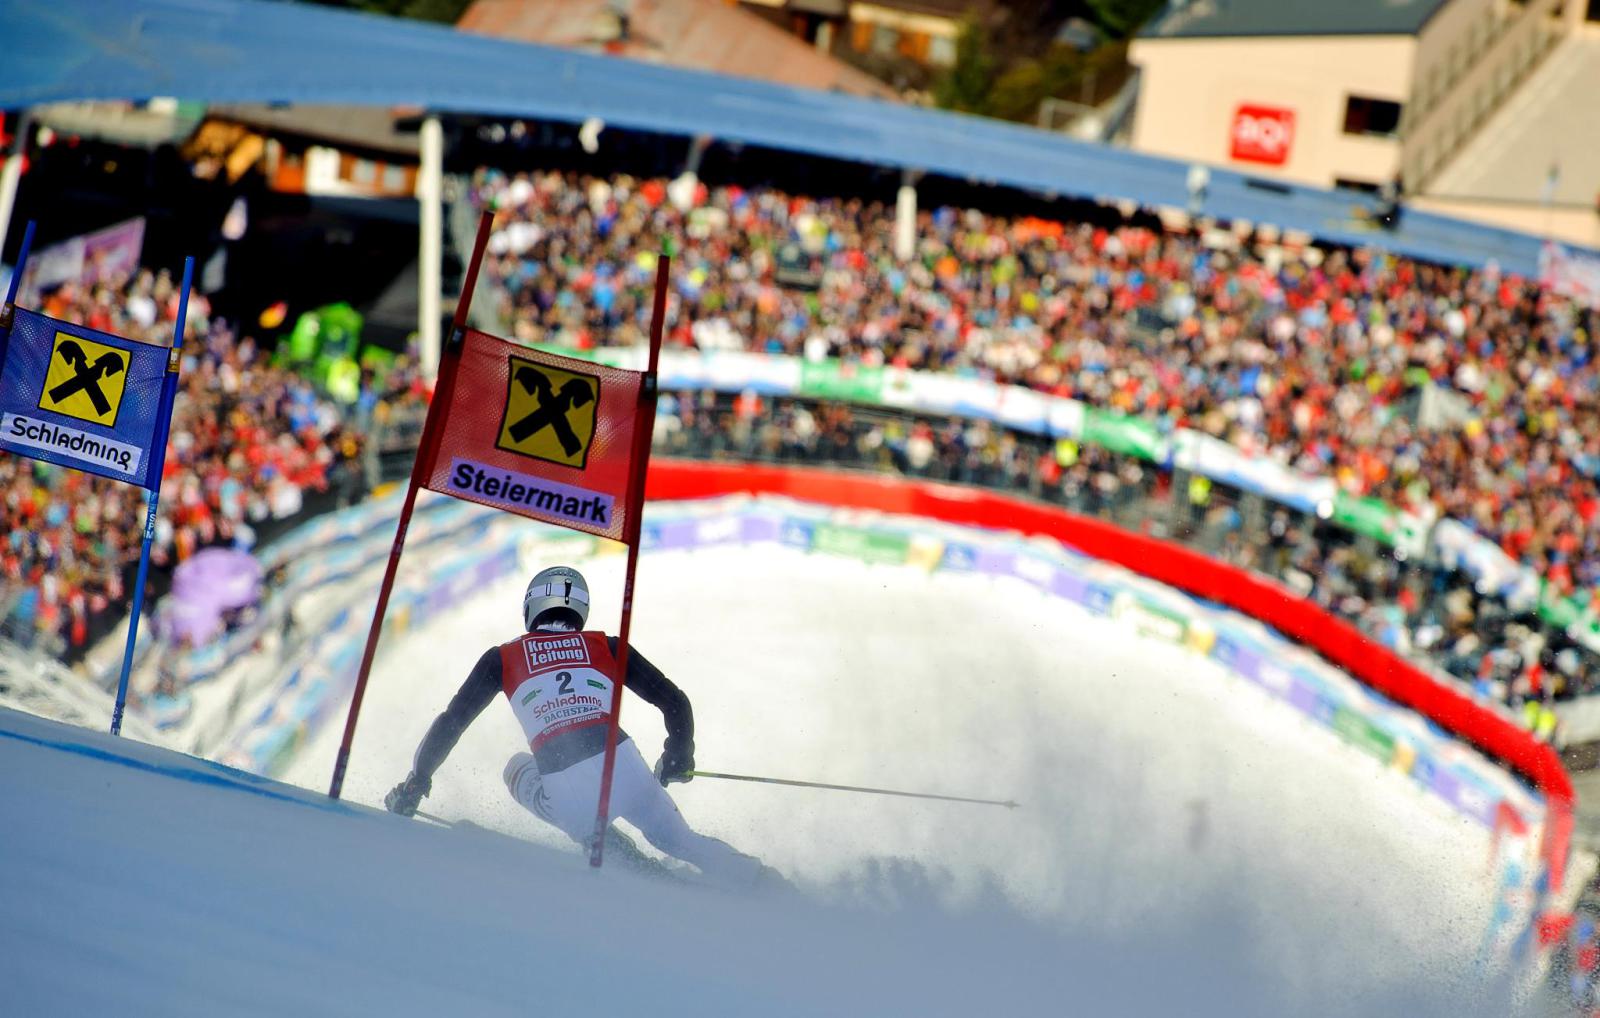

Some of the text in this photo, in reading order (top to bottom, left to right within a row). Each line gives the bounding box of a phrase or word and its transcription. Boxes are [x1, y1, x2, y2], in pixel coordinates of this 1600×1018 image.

[10, 417, 132, 471] Schladming
[453, 463, 607, 523] Steiermark
[528, 637, 581, 653] Kronen
[530, 649, 584, 666] Zeitung
[556, 671, 575, 695] 2
